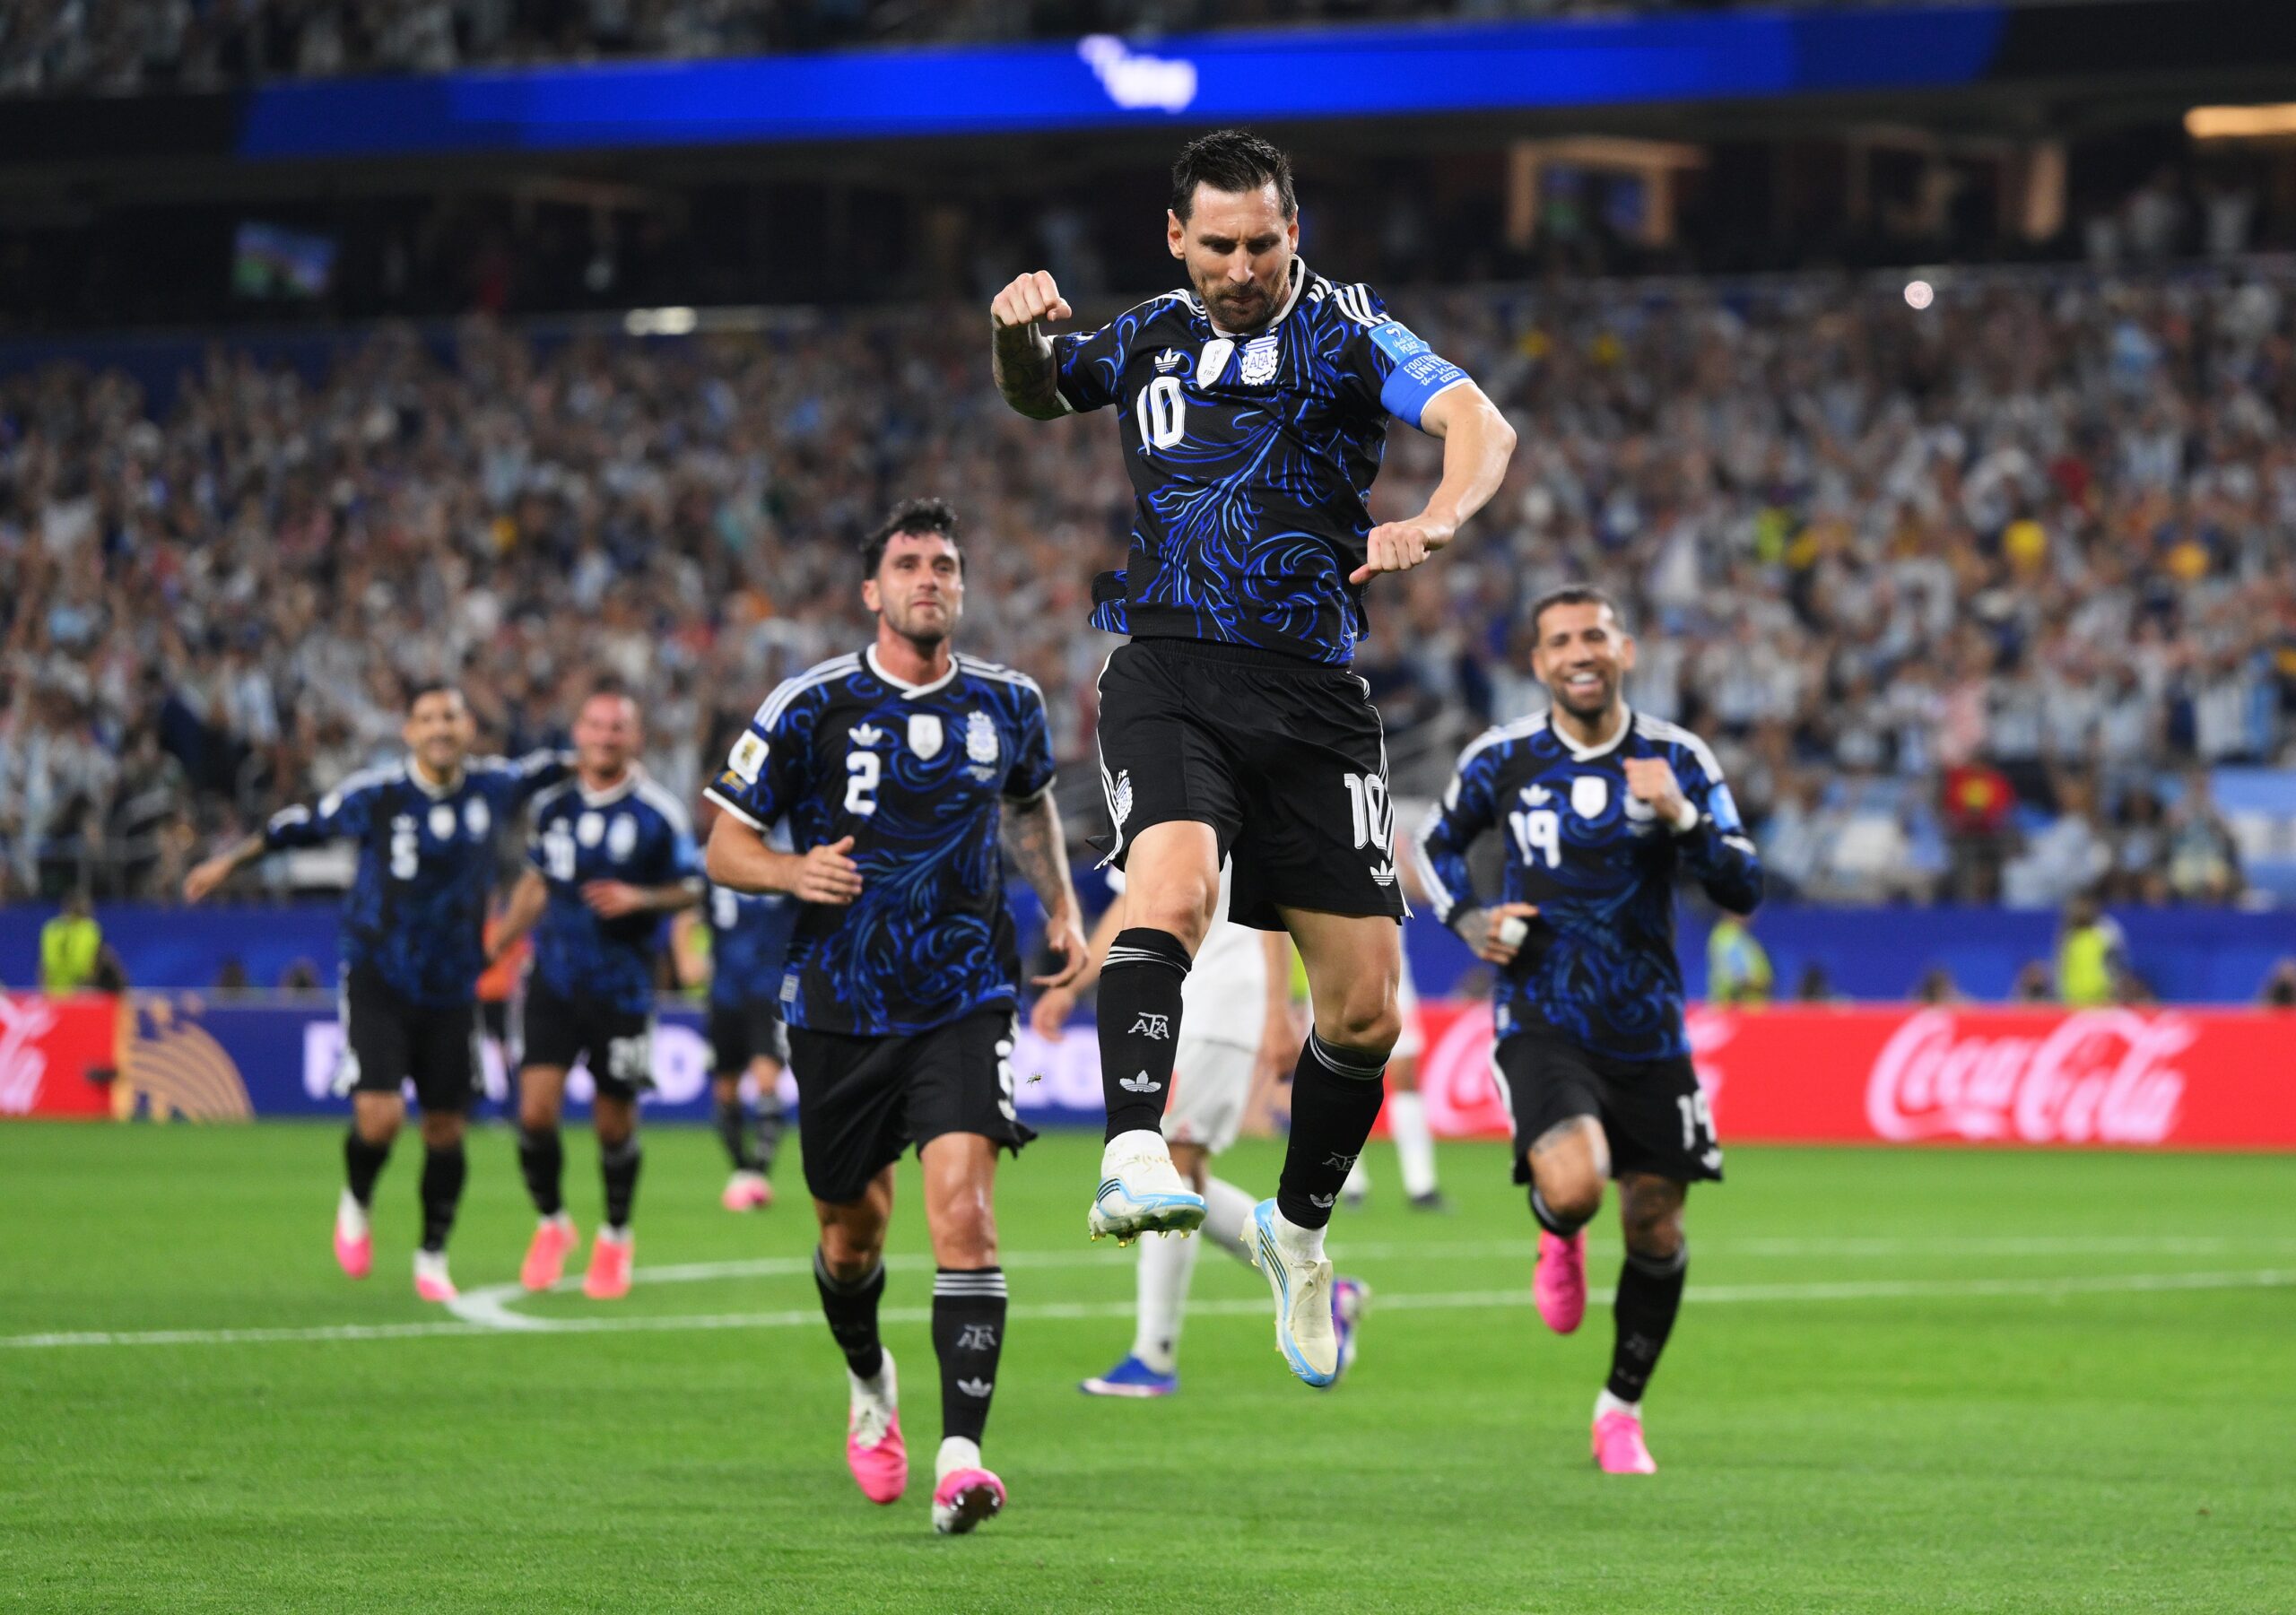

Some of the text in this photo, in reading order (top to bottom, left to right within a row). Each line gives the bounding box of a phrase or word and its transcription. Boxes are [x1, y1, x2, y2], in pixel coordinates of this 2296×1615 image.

[1249, 350, 1269, 369] AFA
[1403, 354, 1439, 374] FOOTB
[1136, 376, 1186, 456] 10
[844, 751, 881, 816] 2
[1509, 810, 1561, 869] 19
[1127, 1012, 1170, 1040] AFA
[1676, 1089, 1718, 1150] 19
